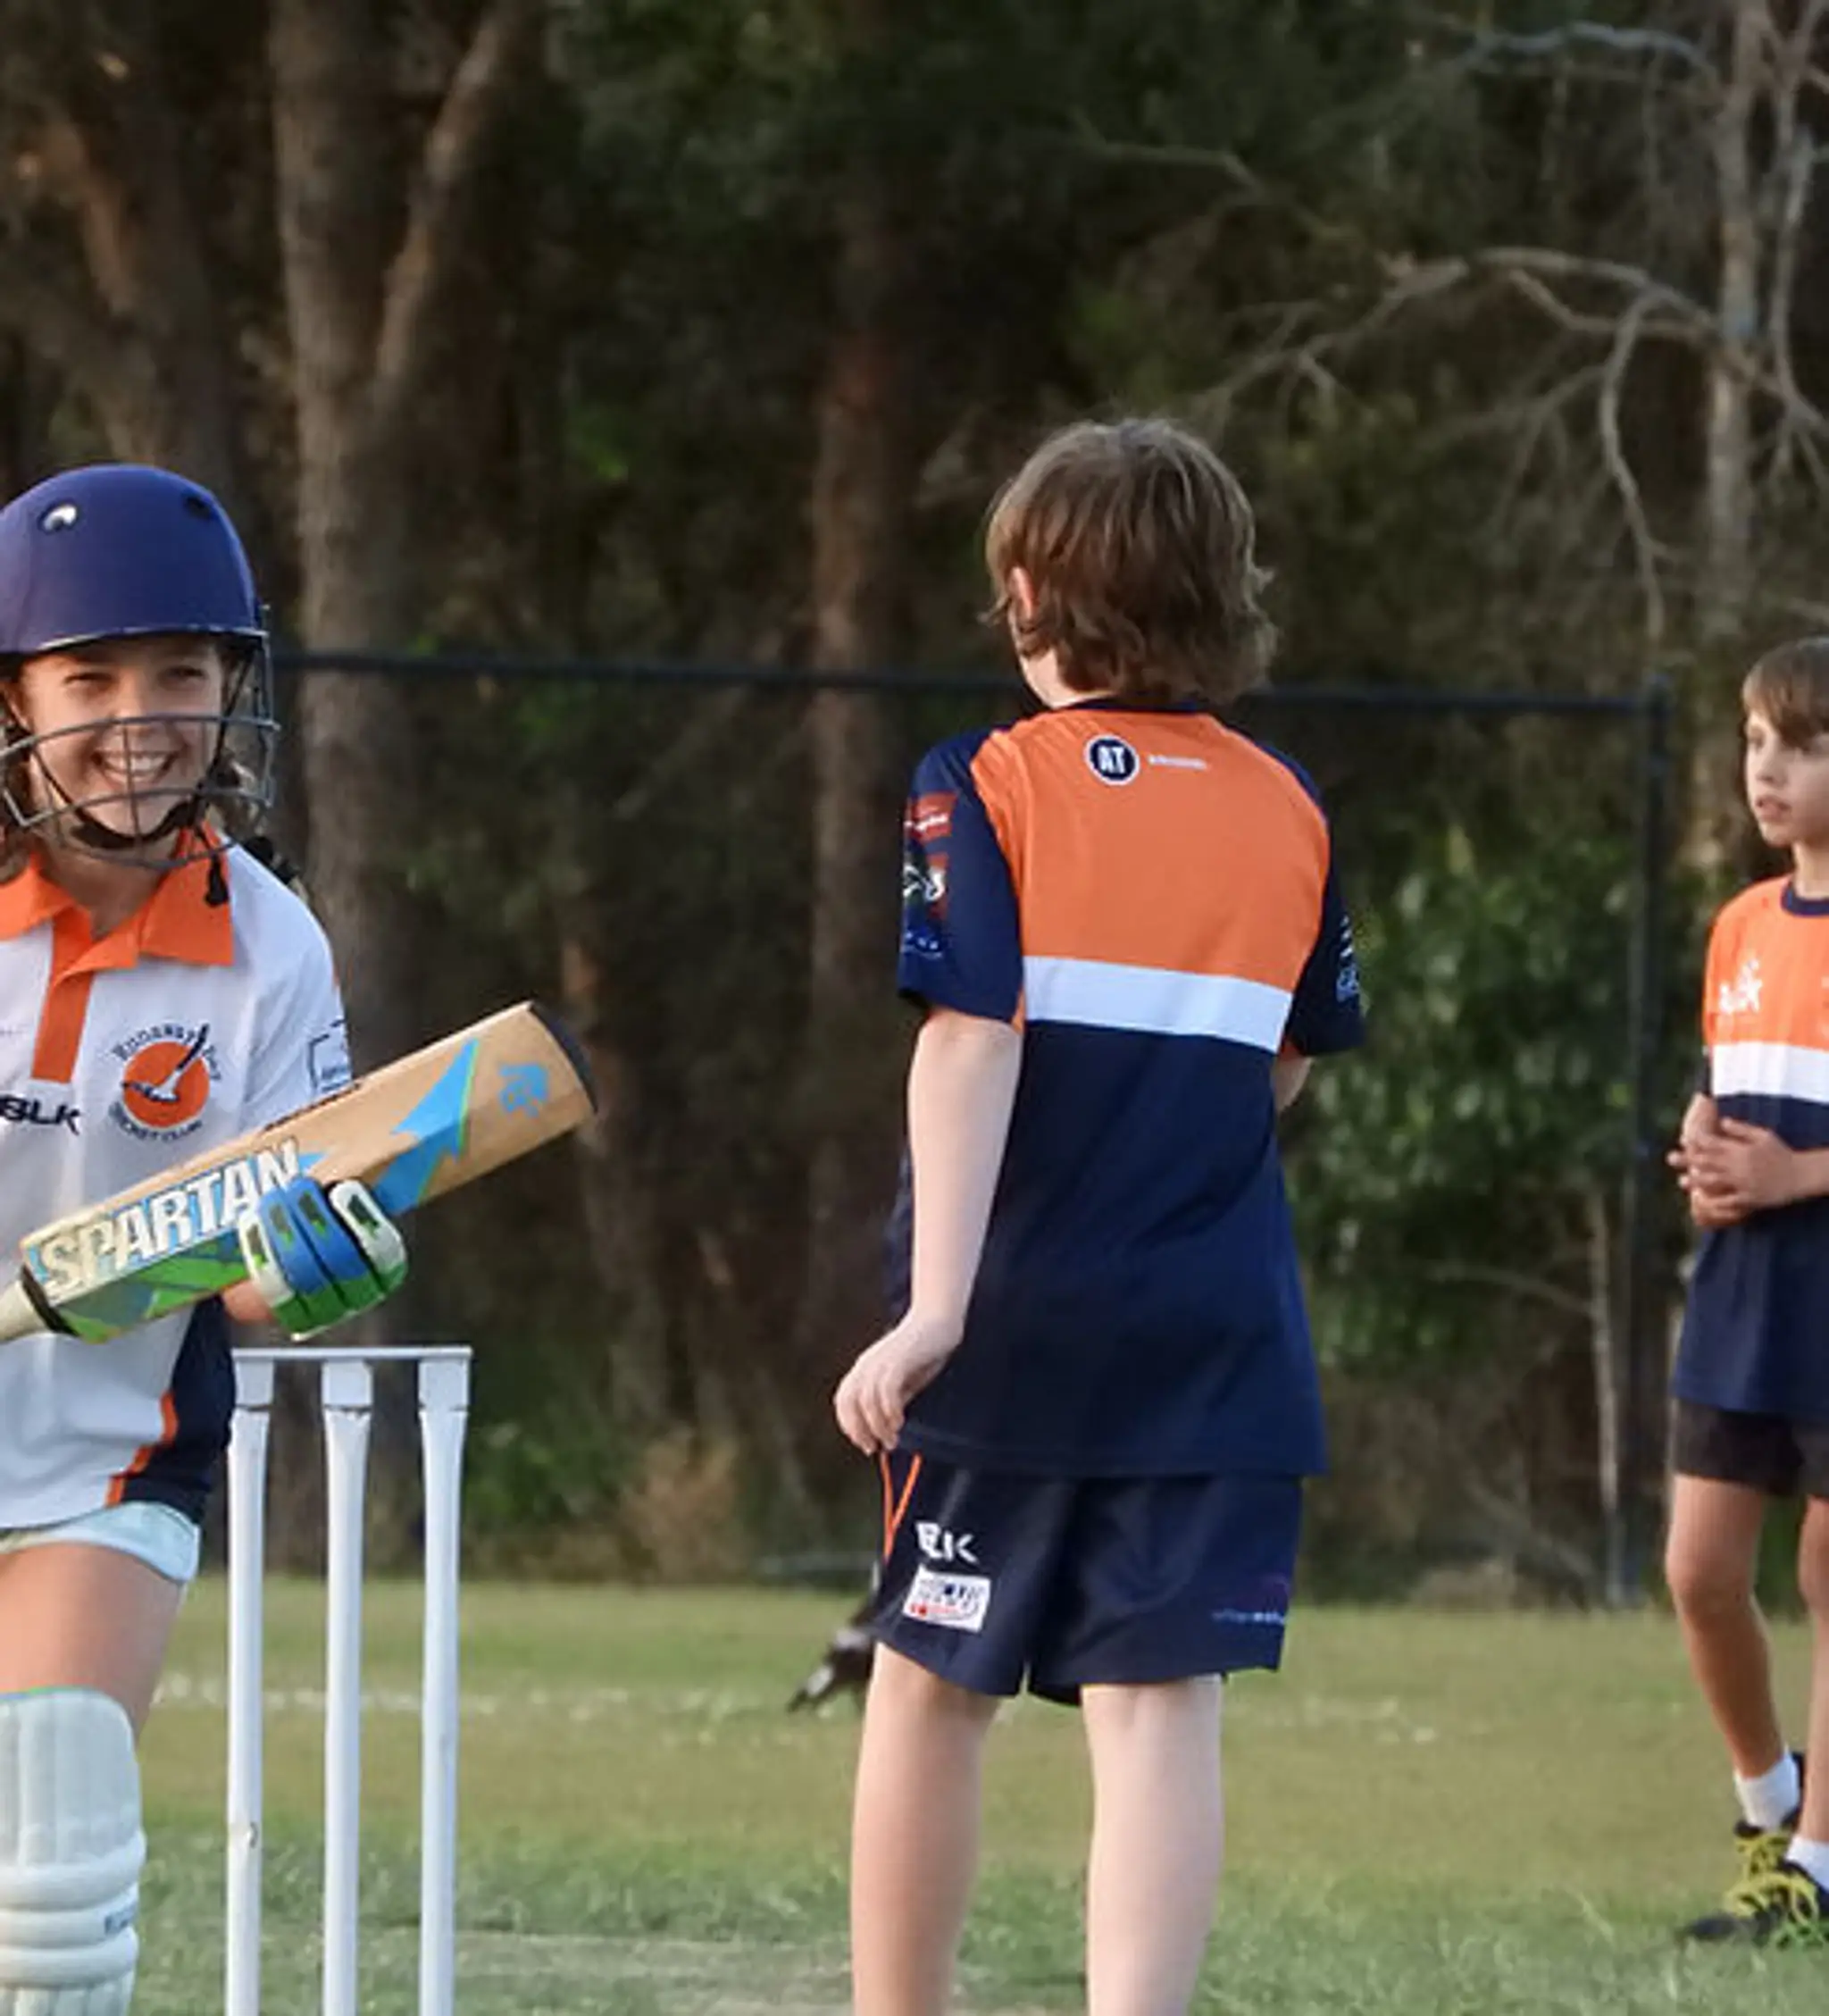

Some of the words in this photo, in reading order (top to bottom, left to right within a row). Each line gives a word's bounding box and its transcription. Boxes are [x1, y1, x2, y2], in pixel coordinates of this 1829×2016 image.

[1098, 745, 1126, 774] AT
[0, 1095, 80, 1136] BLK
[39, 1134, 301, 1290] SPARTAN
